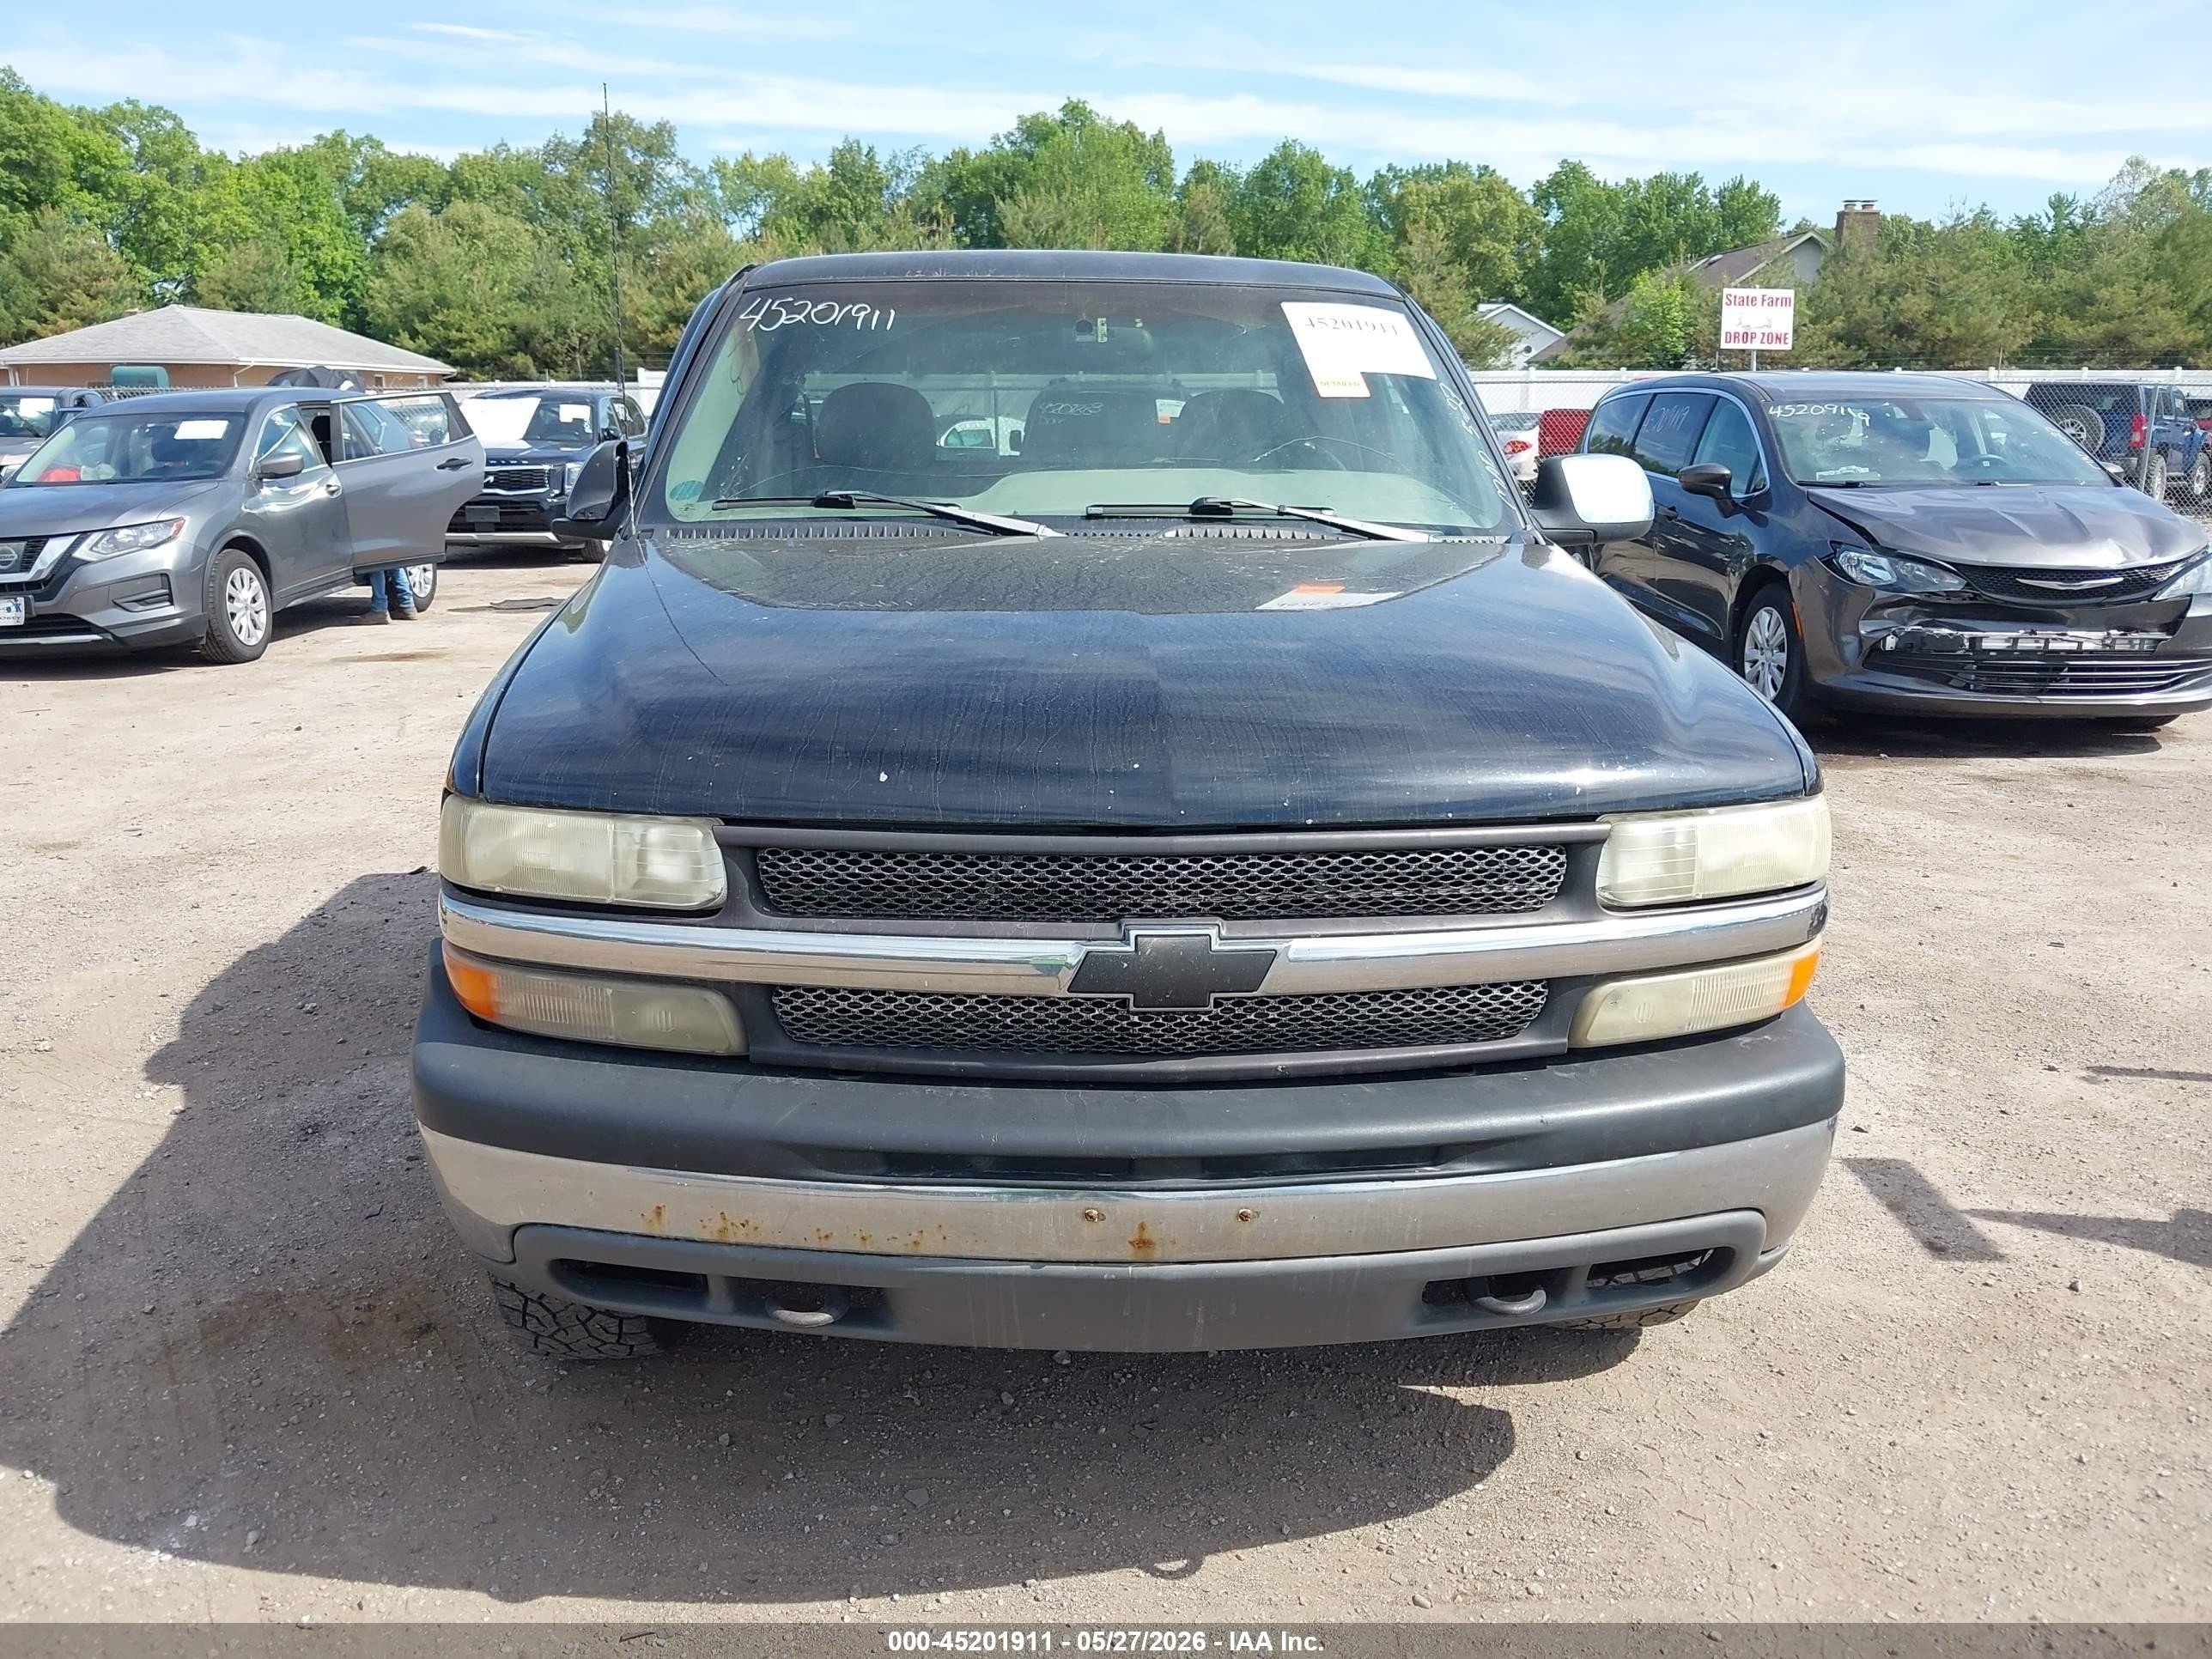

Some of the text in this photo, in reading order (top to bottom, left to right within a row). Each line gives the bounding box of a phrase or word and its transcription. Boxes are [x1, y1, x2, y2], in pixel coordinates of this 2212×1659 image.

[1725, 293, 1792, 307] State Farm
[738, 296, 896, 331] 45201911
[1304, 316, 1399, 336] 45201911
[1724, 331, 1789, 345] DROP ZONE
[1768, 404, 1870, 427] 45209119
